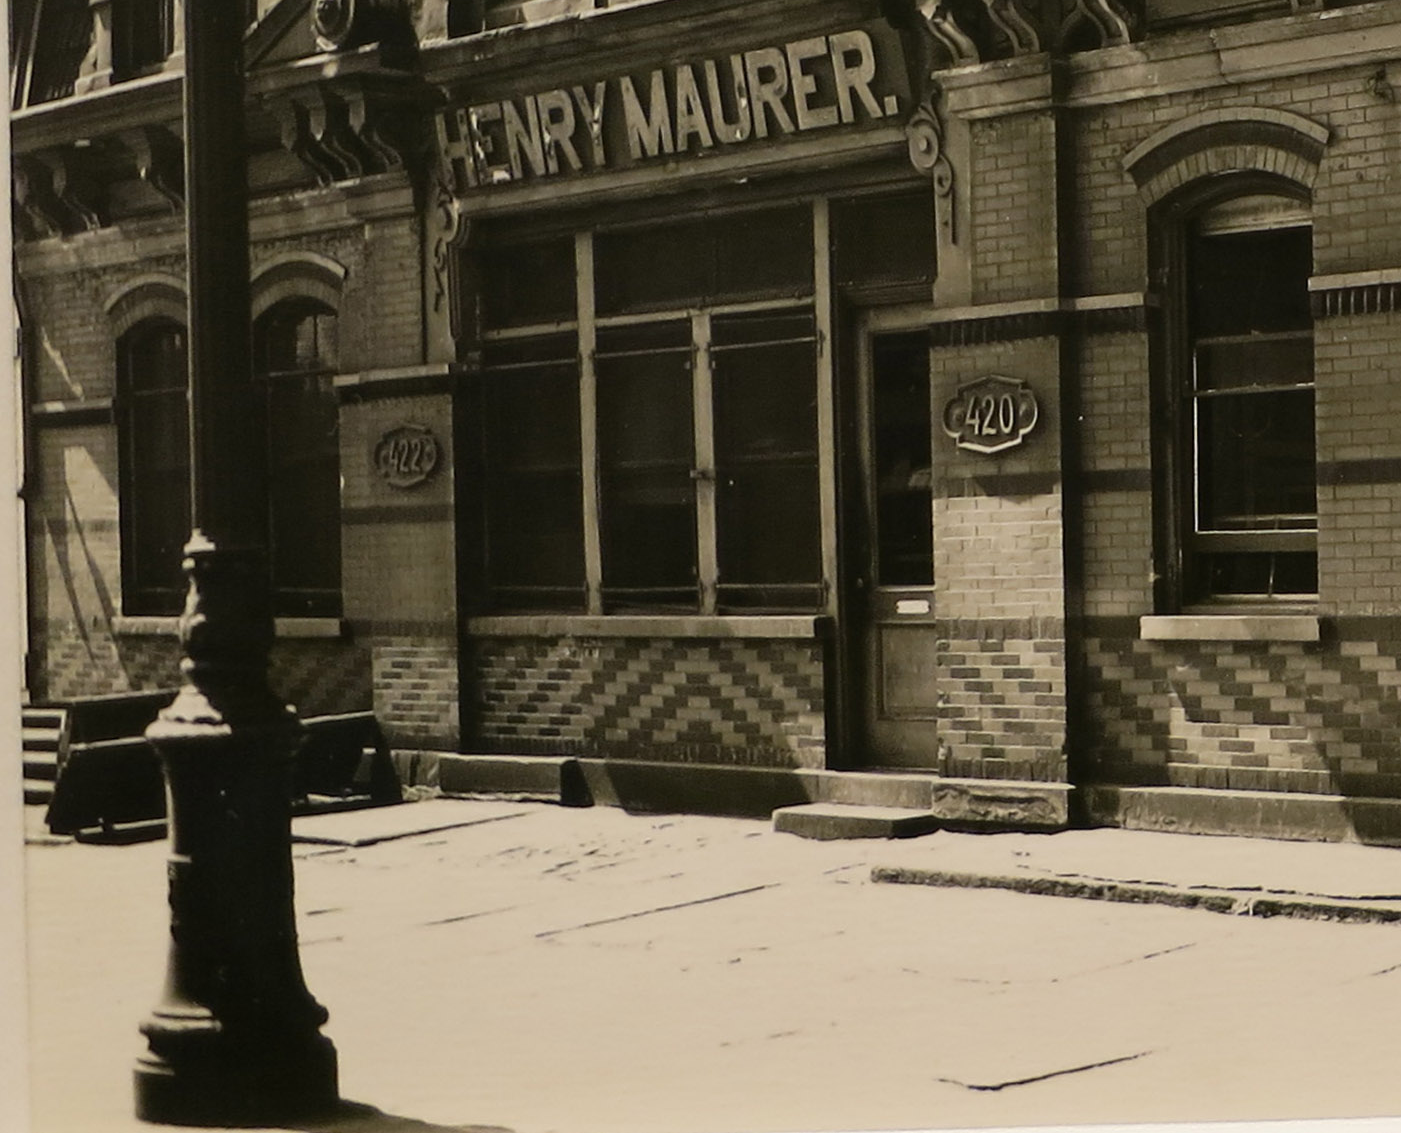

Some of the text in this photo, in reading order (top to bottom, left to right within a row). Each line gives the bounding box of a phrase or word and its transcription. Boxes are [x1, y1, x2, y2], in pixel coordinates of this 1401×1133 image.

[435, 29, 899, 189] HENRY MAURER.
[965, 393, 1014, 436] 420
[389, 438, 421, 473] 422
